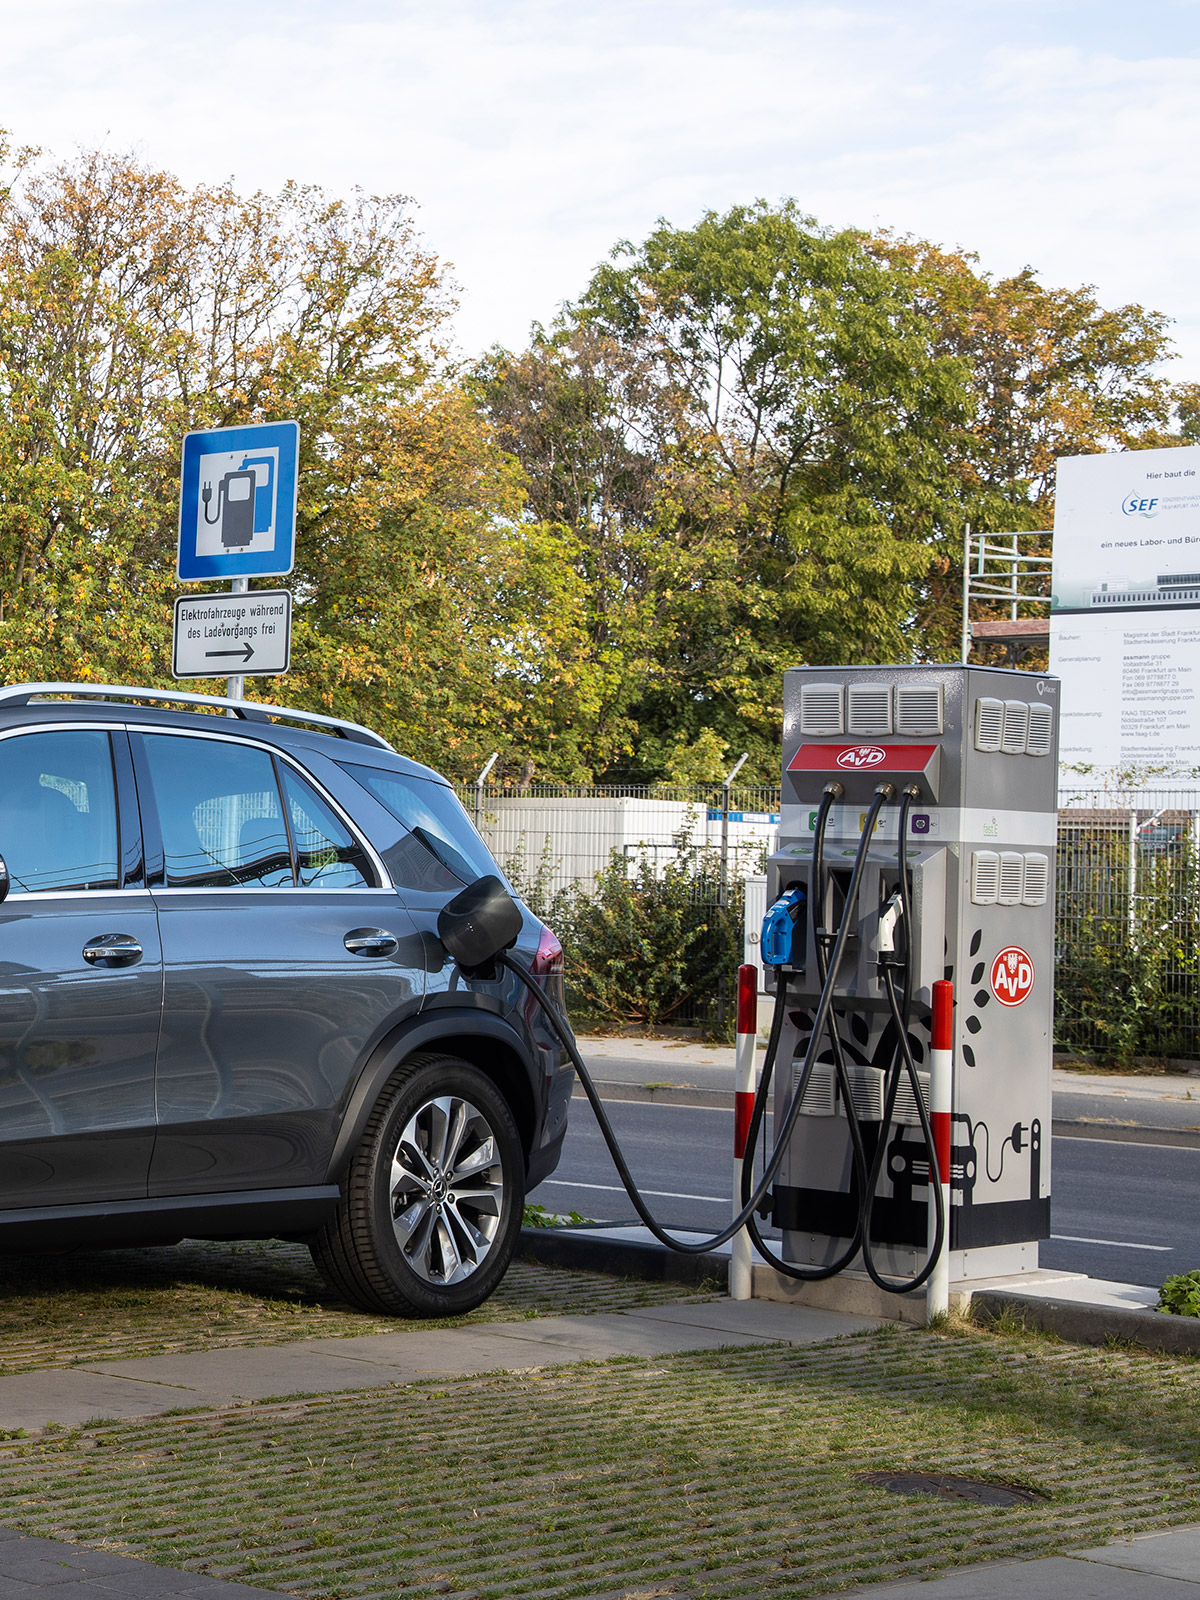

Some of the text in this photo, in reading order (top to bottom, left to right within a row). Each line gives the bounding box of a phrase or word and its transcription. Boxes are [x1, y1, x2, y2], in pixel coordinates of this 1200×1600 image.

[1146, 472, 1162, 480] Hier
[1183, 469, 1196, 477] die
[1128, 498, 1159, 512] SEF
[1100, 541, 1112, 549] ein
[1114, 539, 1138, 548] neues
[1139, 538, 1165, 547] Labor-
[1167, 536, 1183, 545] und
[181, 603, 284, 621] Elektrofahrzeuge während
[187, 622, 276, 639] des Ladevorgangs frei
